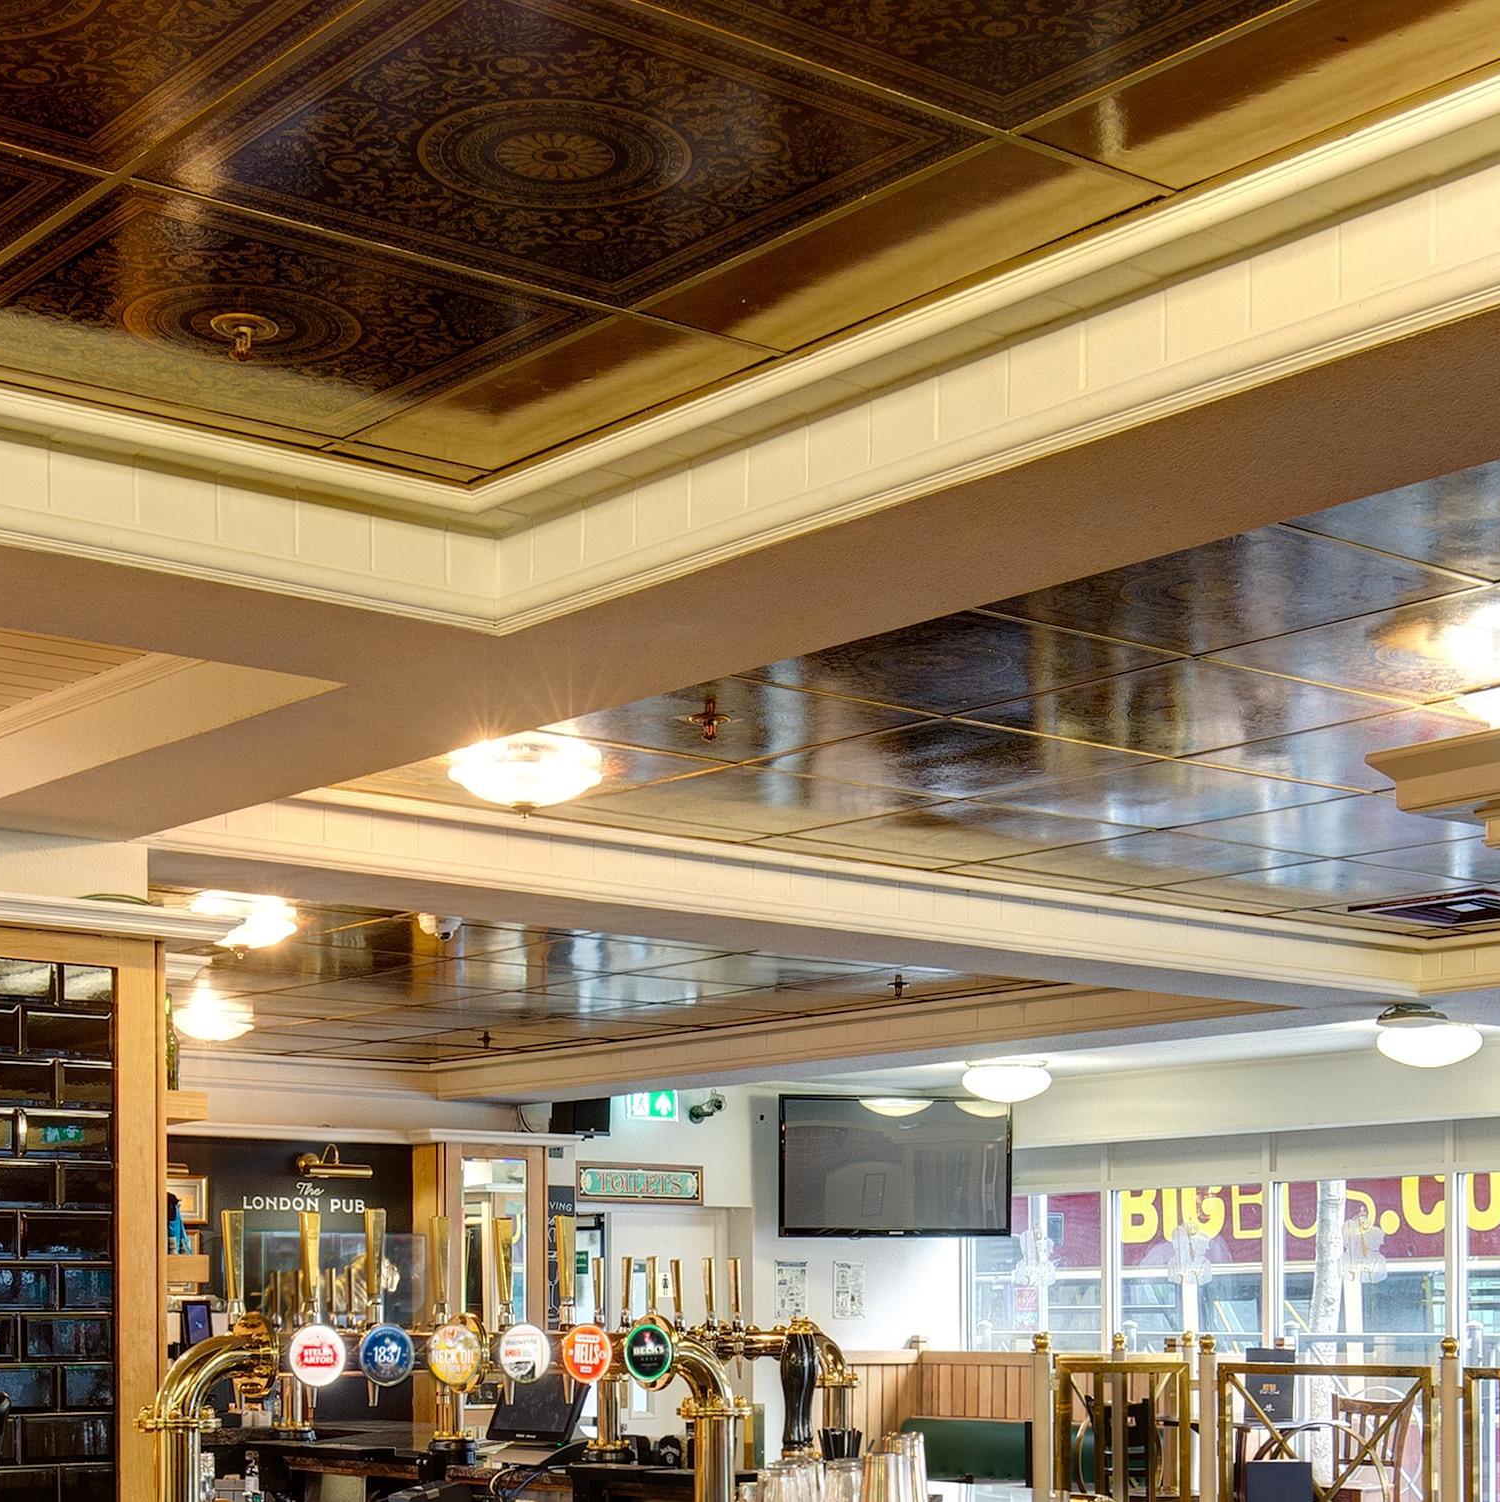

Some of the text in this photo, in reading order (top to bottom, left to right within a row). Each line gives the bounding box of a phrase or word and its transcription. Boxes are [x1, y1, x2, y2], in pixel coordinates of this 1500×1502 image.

[296, 1182, 325, 1196] The
[597, 1171, 685, 1195] TOILETS
[242, 1195, 366, 1214] LONDON PUB
[549, 1200, 573, 1212] VING
[373, 1345, 402, 1363] 1837
[574, 1342, 600, 1366] HELLS
